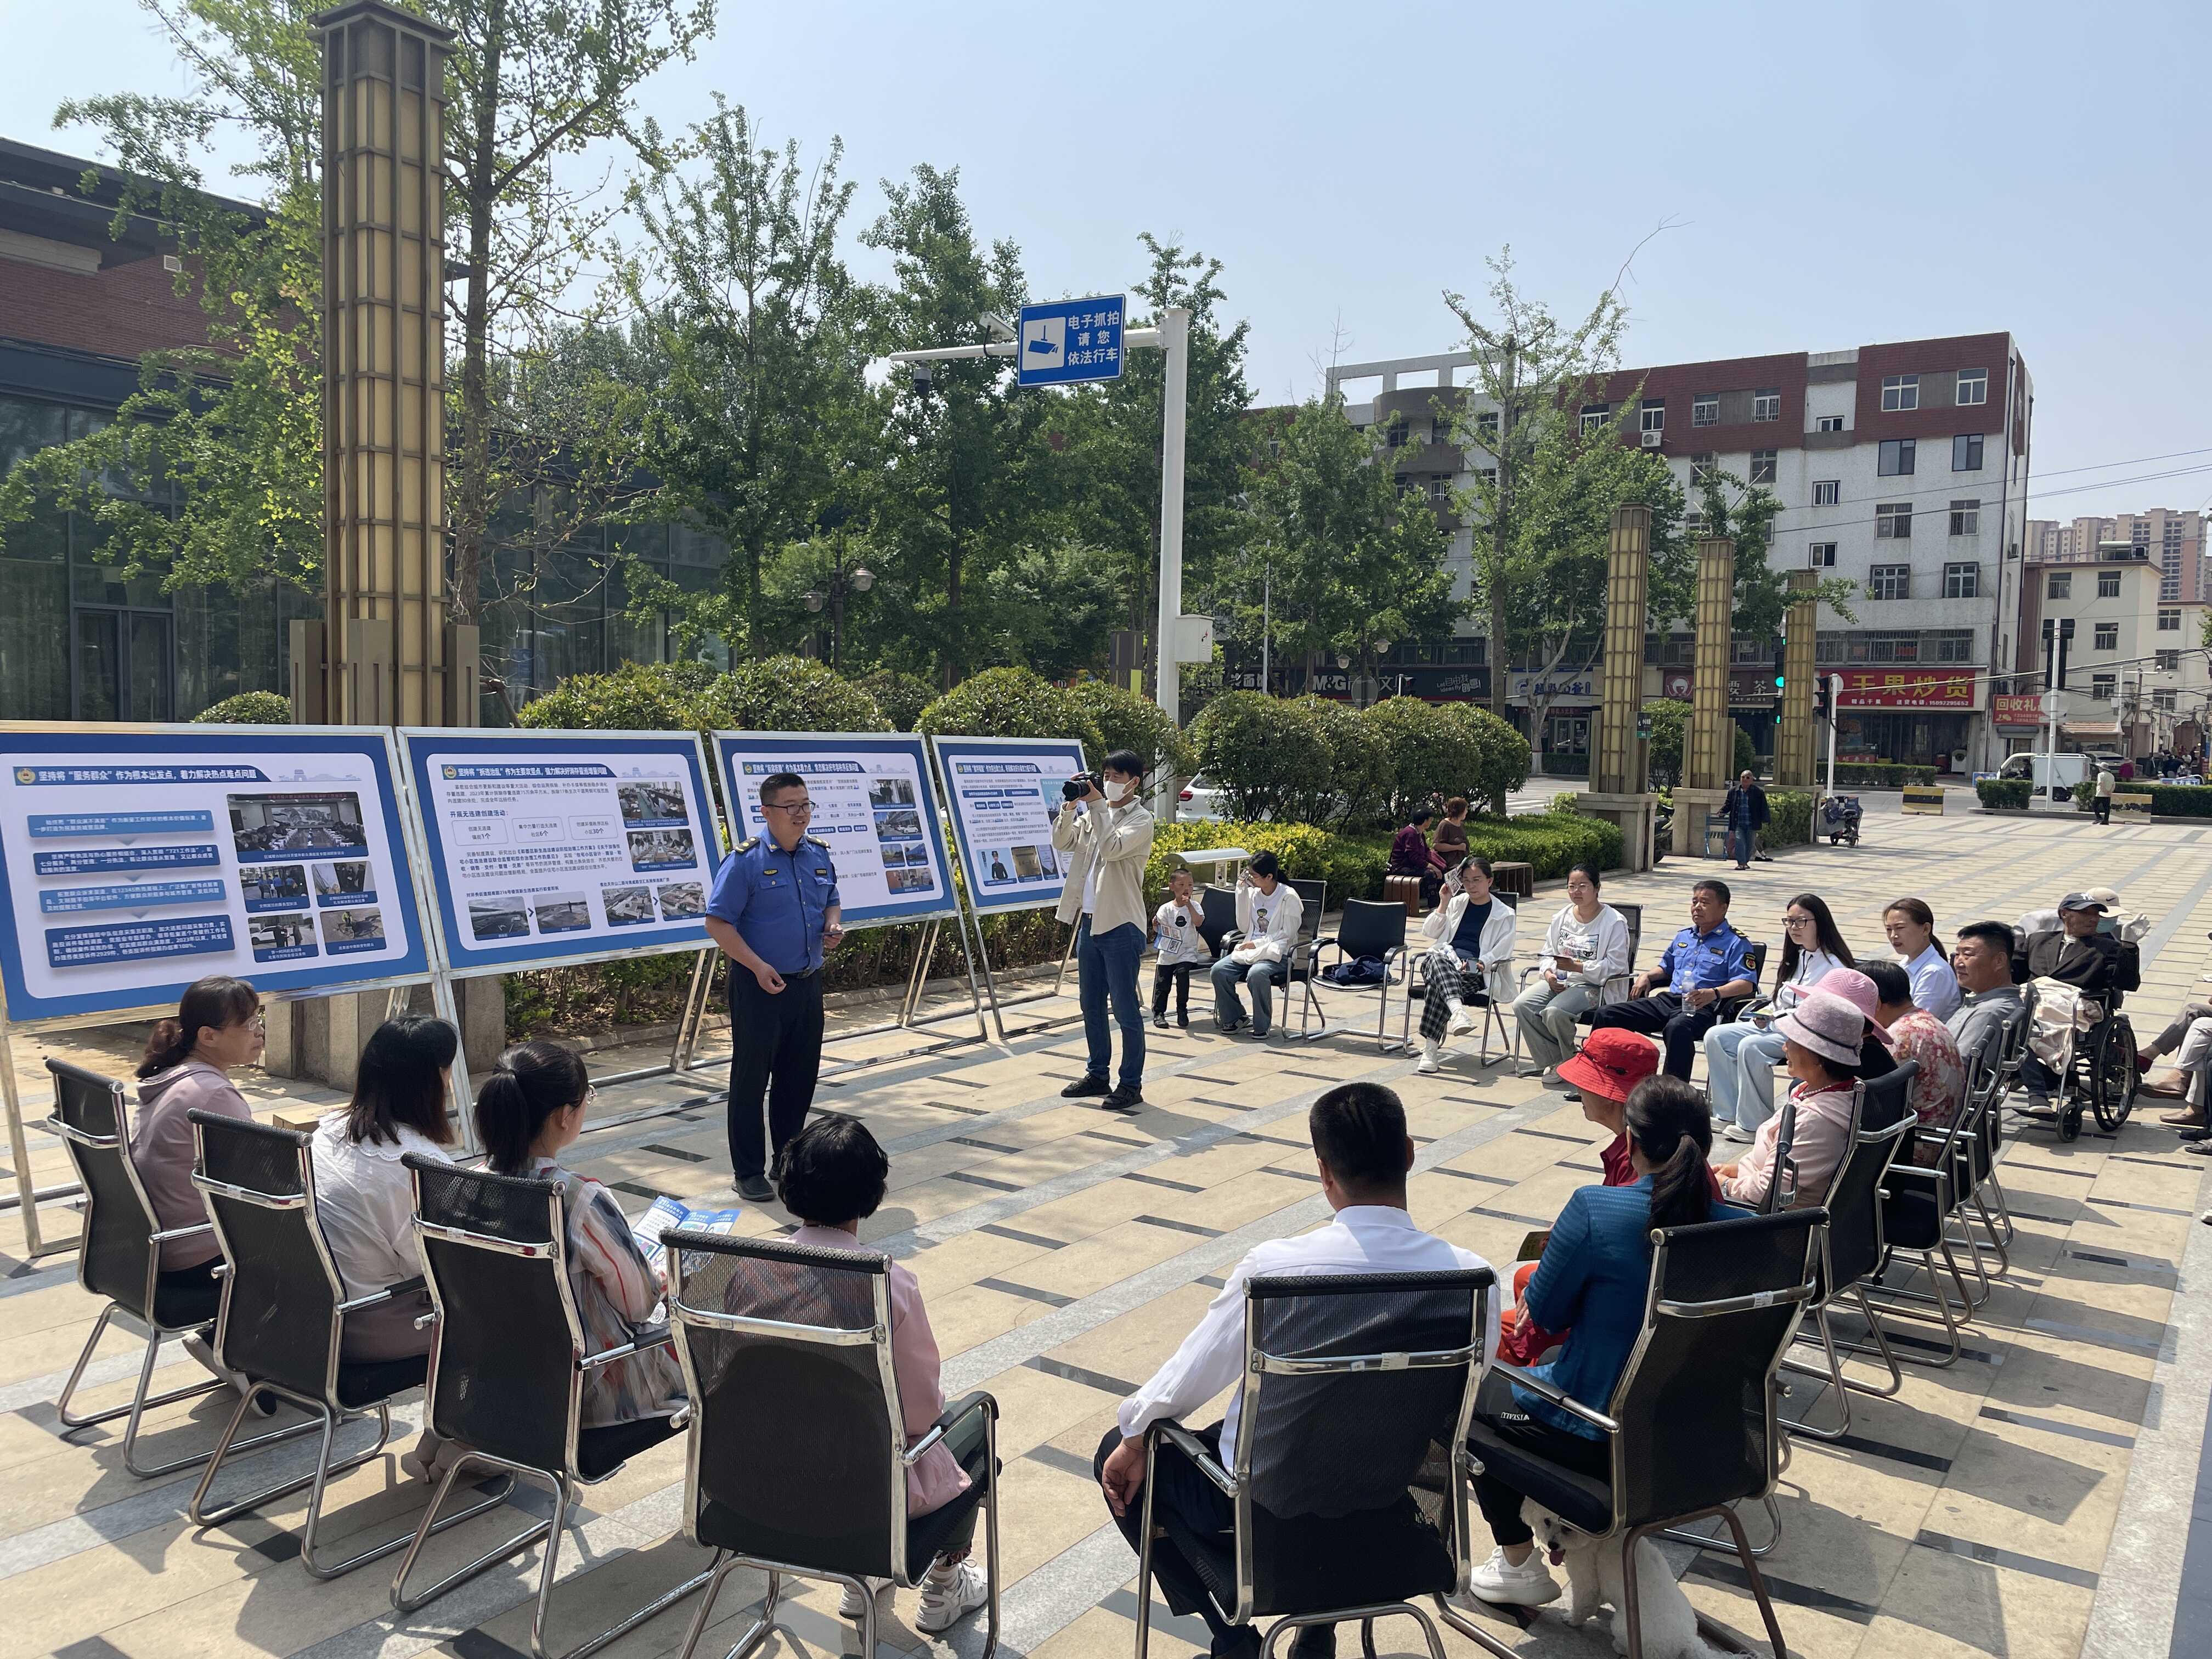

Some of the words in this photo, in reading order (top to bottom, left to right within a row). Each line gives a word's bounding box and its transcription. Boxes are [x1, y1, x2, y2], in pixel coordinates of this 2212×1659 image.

[1068, 311, 1120, 330] 电子抓拍
[1068, 347, 1119, 366] 依法行车
[1313, 675, 1347, 691] M&G
[1852, 674, 1968, 698] 干果炒货
